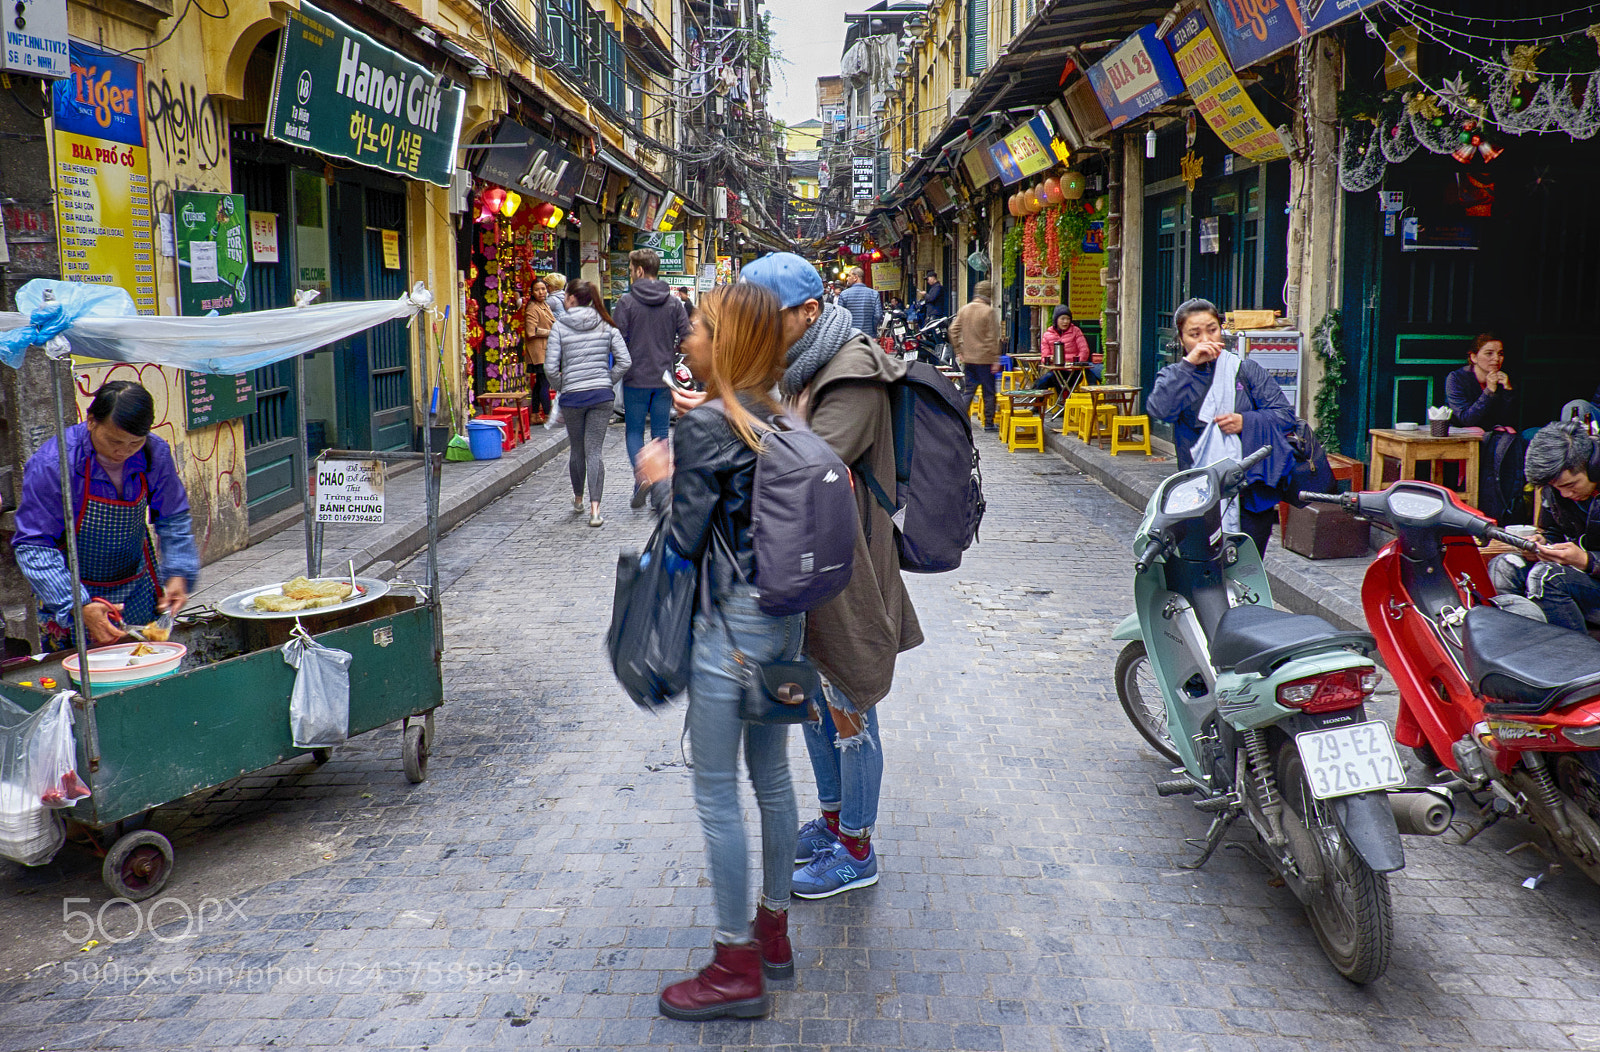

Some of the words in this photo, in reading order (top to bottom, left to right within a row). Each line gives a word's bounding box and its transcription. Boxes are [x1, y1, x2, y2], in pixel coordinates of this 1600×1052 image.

[1106, 58, 1136, 90] BIA
[1132, 50, 1152, 75] 23
[300, 79, 310, 98] 18
[337, 36, 406, 118] Hanoi
[406, 75, 442, 132] Gift
[71, 63, 133, 128] Tiger
[79, 107, 93, 116] SINCE
[349, 110, 395, 164] 하노이
[397, 128, 422, 172] 선물
[72, 143, 93, 160] BIA
[95, 145, 117, 164] PHỐ
[63, 163, 71, 171] BIA
[64, 188, 72, 196] BIA
[66, 213, 74, 221] BIA
[66, 225, 74, 233] BIA
[227, 235, 242, 249] FOR
[67, 250, 76, 258] BIA
[227, 248, 243, 264] FUN
[68, 262, 76, 270] BIA
[300, 268, 326, 281] WELCOME
[319, 469, 344, 486] CHÁO
[320, 502, 345, 513] BÁNH
[348, 504, 382, 513] CHƯNG
[1322, 715, 1352, 725] HONDA
[1311, 727, 1381, 762] 29-E2
[1313, 756, 1399, 793] 326.12
[836, 865, 857, 883] N
